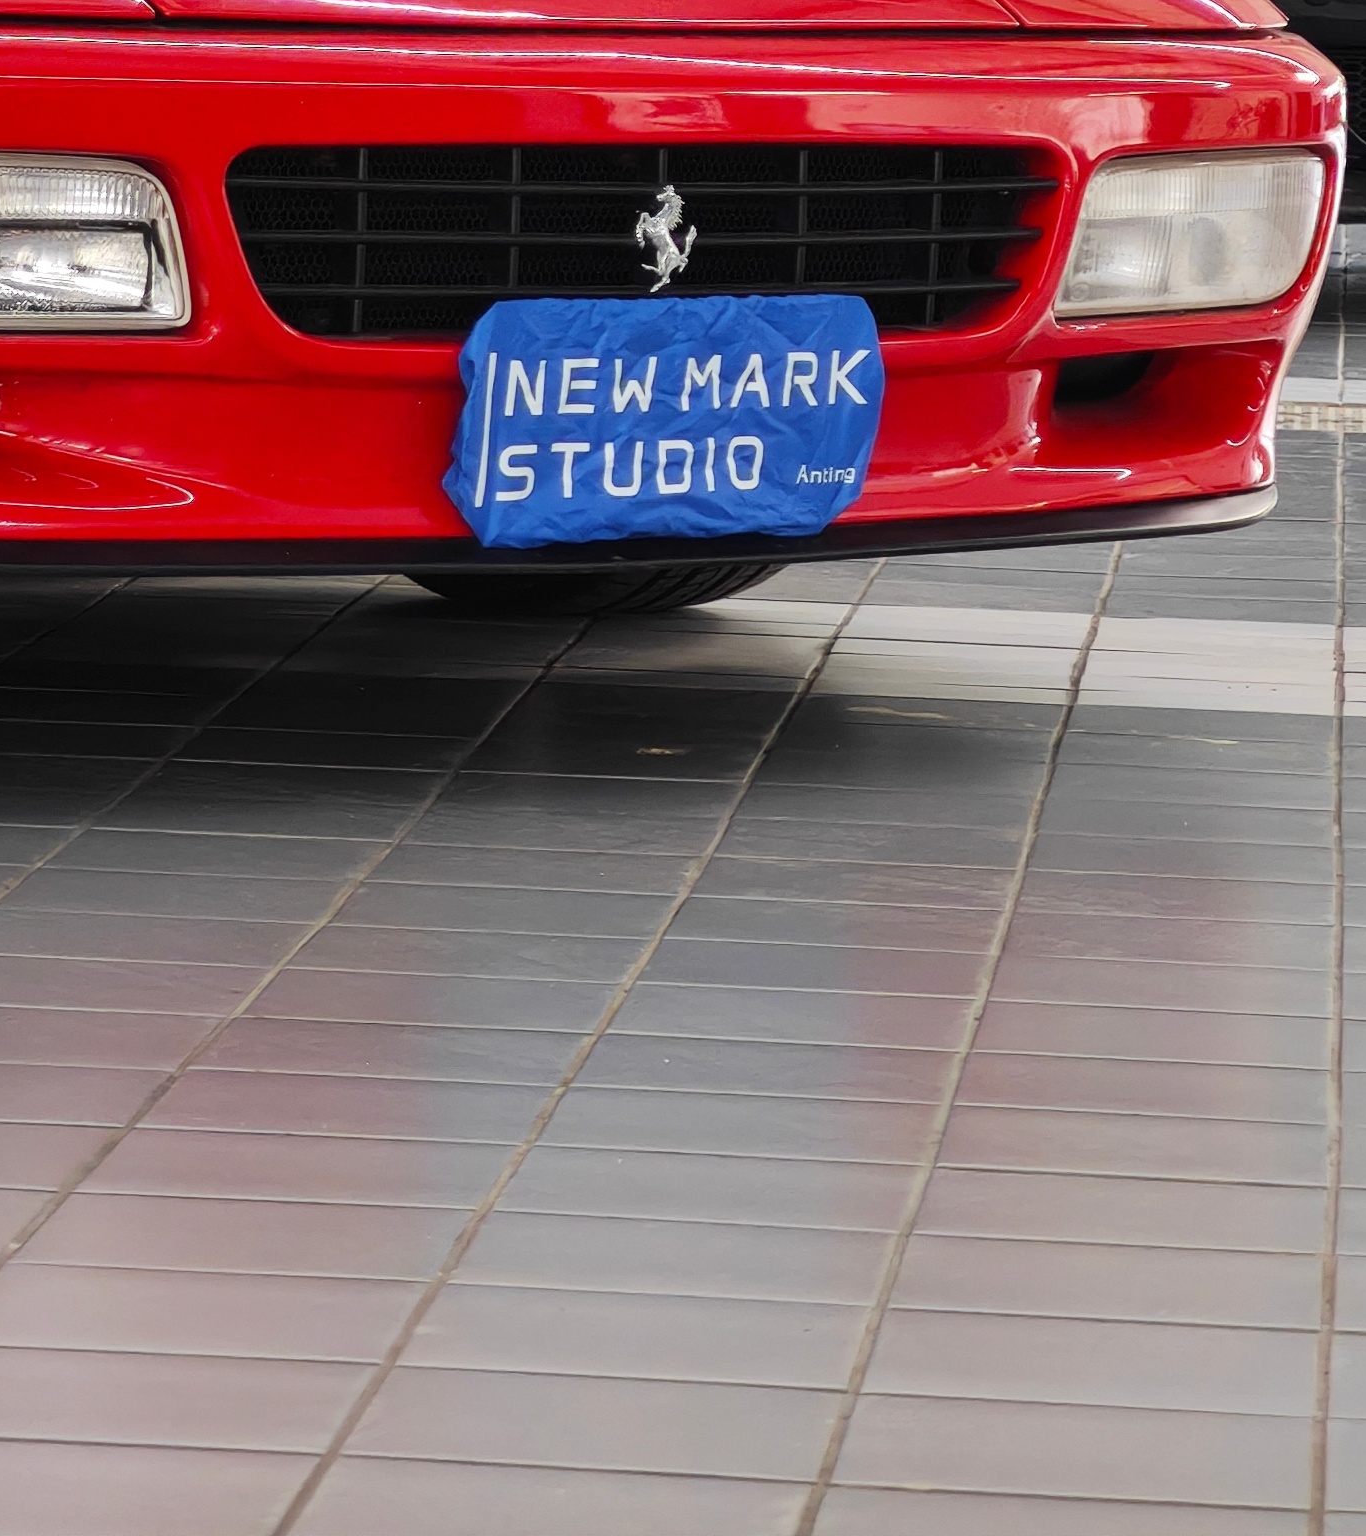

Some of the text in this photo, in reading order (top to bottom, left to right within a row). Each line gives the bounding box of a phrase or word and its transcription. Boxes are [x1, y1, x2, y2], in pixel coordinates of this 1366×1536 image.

[504, 349, 871, 417] NEW MARK
[495, 435, 764, 502] STUDIO
[796, 464, 856, 485] Anting
